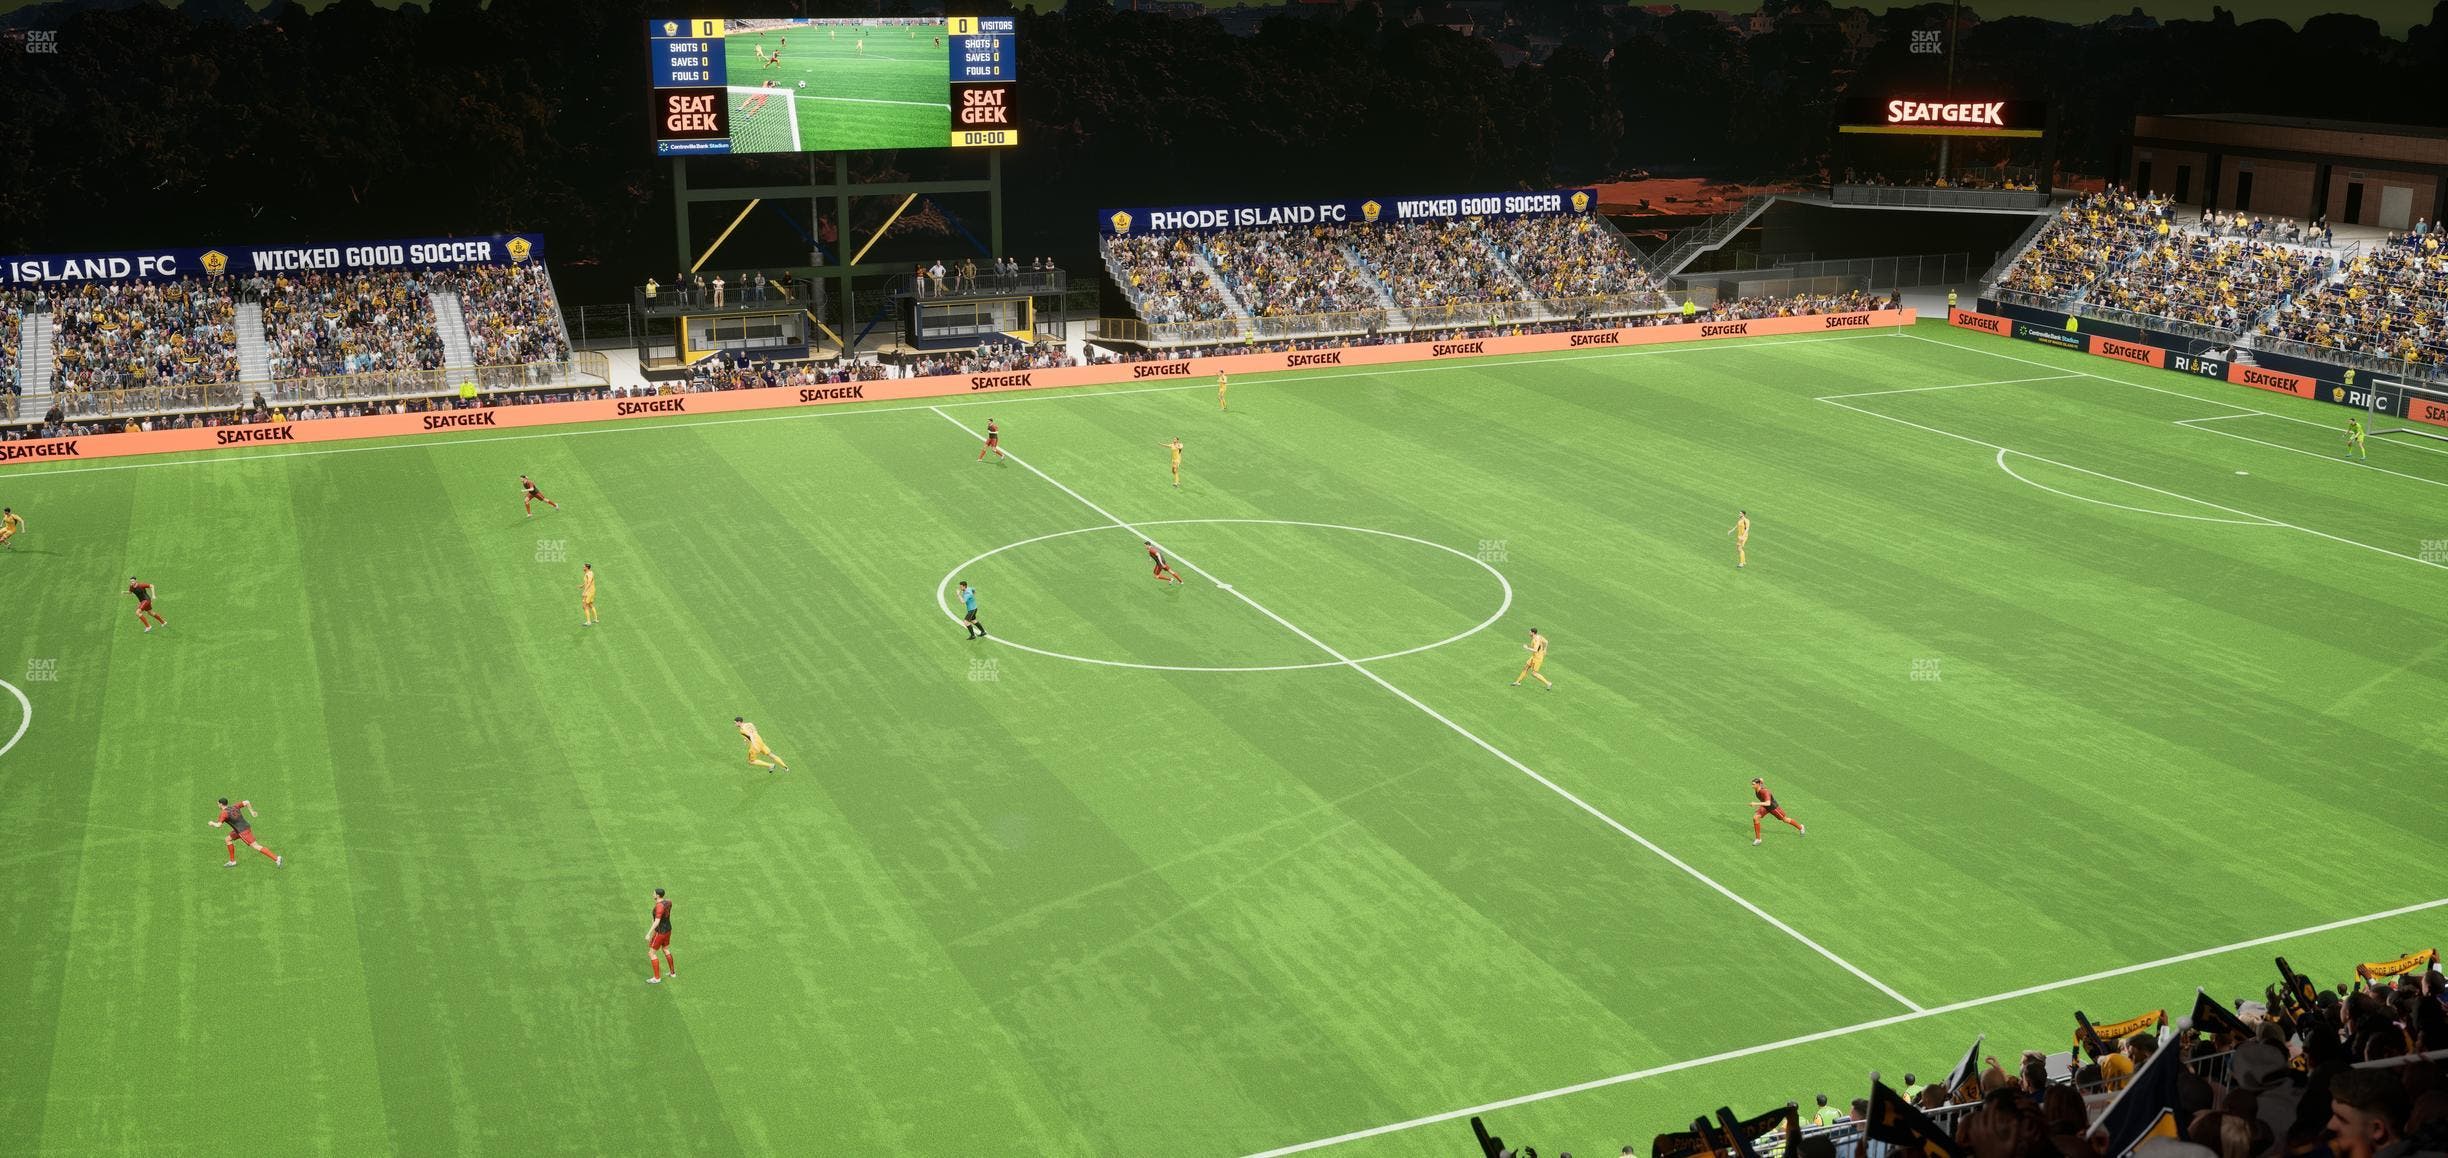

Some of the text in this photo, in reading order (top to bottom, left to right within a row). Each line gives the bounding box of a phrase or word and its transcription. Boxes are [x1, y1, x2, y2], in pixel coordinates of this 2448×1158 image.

[703, 21, 712, 36] 0
[959, 19, 1013, 33] 0 VISITORS
[670, 43, 708, 52] SHOTS 0
[965, 39, 999, 48] SHOTS 0
[671, 57, 708, 67] SAVES 0
[965, 53, 999, 62] SAVES 0
[672, 71, 709, 81] FOULS 0
[966, 66, 1000, 76] FOULS 0
[668, 95, 715, 113] SEAT
[963, 89, 1005, 106] SEAT
[961, 106, 1007, 124] GEEK
[1888, 100, 2004, 125] SEATGEEK
[667, 113, 719, 132] GEEK
[965, 131, 1005, 145] 00:00
[1397, 195, 1561, 219] WICKED GOOD SOCCER
[1150, 204, 1346, 230] RHODE ISLAND FC
[252, 241, 491, 271] WICKED GOOD SOCCER
[10, 258, 131, 283] ISLAND
[137, 255, 177, 276] FC
[1700, 323, 1748, 338] SEATGEEK
[1826, 314, 1870, 329] SEATGEEK
[1958, 313, 2000, 333] SEATGEEK
[1570, 331, 1620, 346] SEATGEEK
[1432, 341, 1485, 357] SEATGEEK
[2102, 342, 2151, 363] SEATGEEK
[1286, 351, 1342, 368] SEATGEEK
[1133, 361, 1191, 379] SEATGEEK
[971, 371, 1031, 391] SEATGEEK
[2243, 369, 2300, 394] SEATGEEK
[799, 383, 864, 403] SEATGEEK
[618, 399, 687, 417] SEATGEEK
[423, 411, 496, 431] SEATGEEK
[216, 425, 294, 445] SEATGEEK
